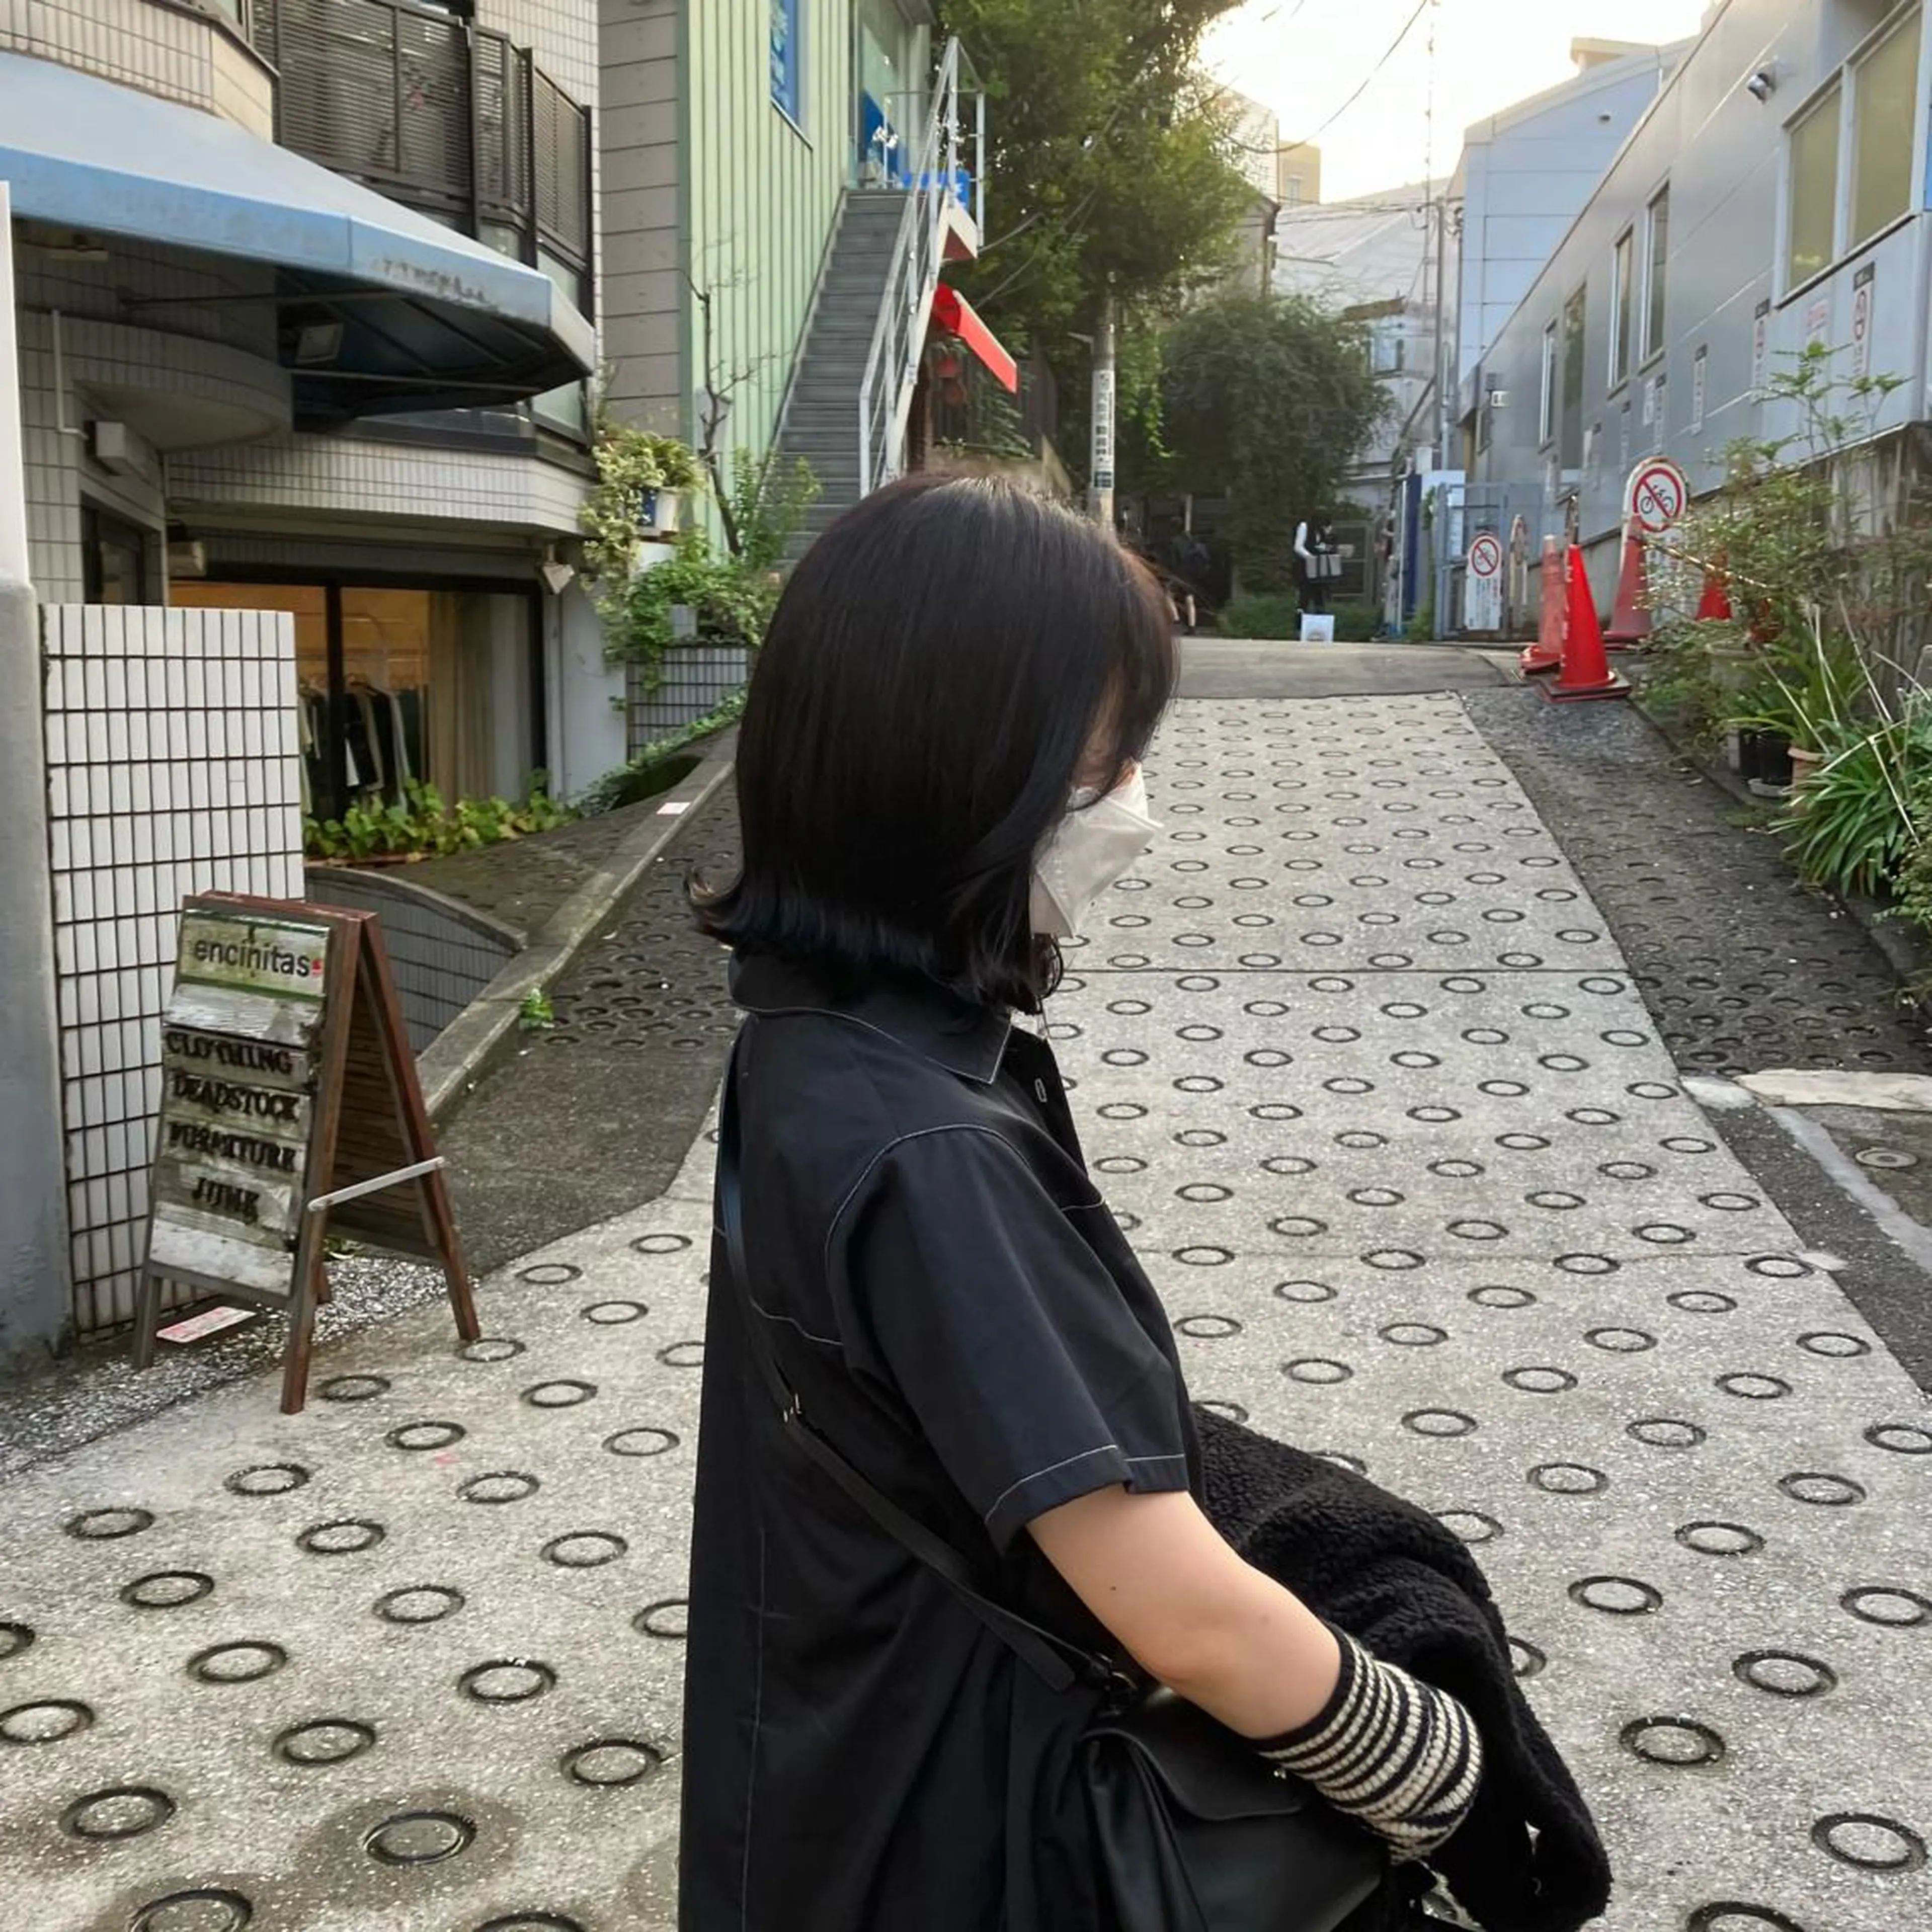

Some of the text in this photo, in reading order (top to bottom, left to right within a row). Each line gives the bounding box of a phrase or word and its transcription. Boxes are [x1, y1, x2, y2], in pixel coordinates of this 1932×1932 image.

[194, 940, 310, 977] encinitas
[167, 1032, 292, 1075] CLOTHING
[174, 1073, 300, 1123] DEADSTOCK
